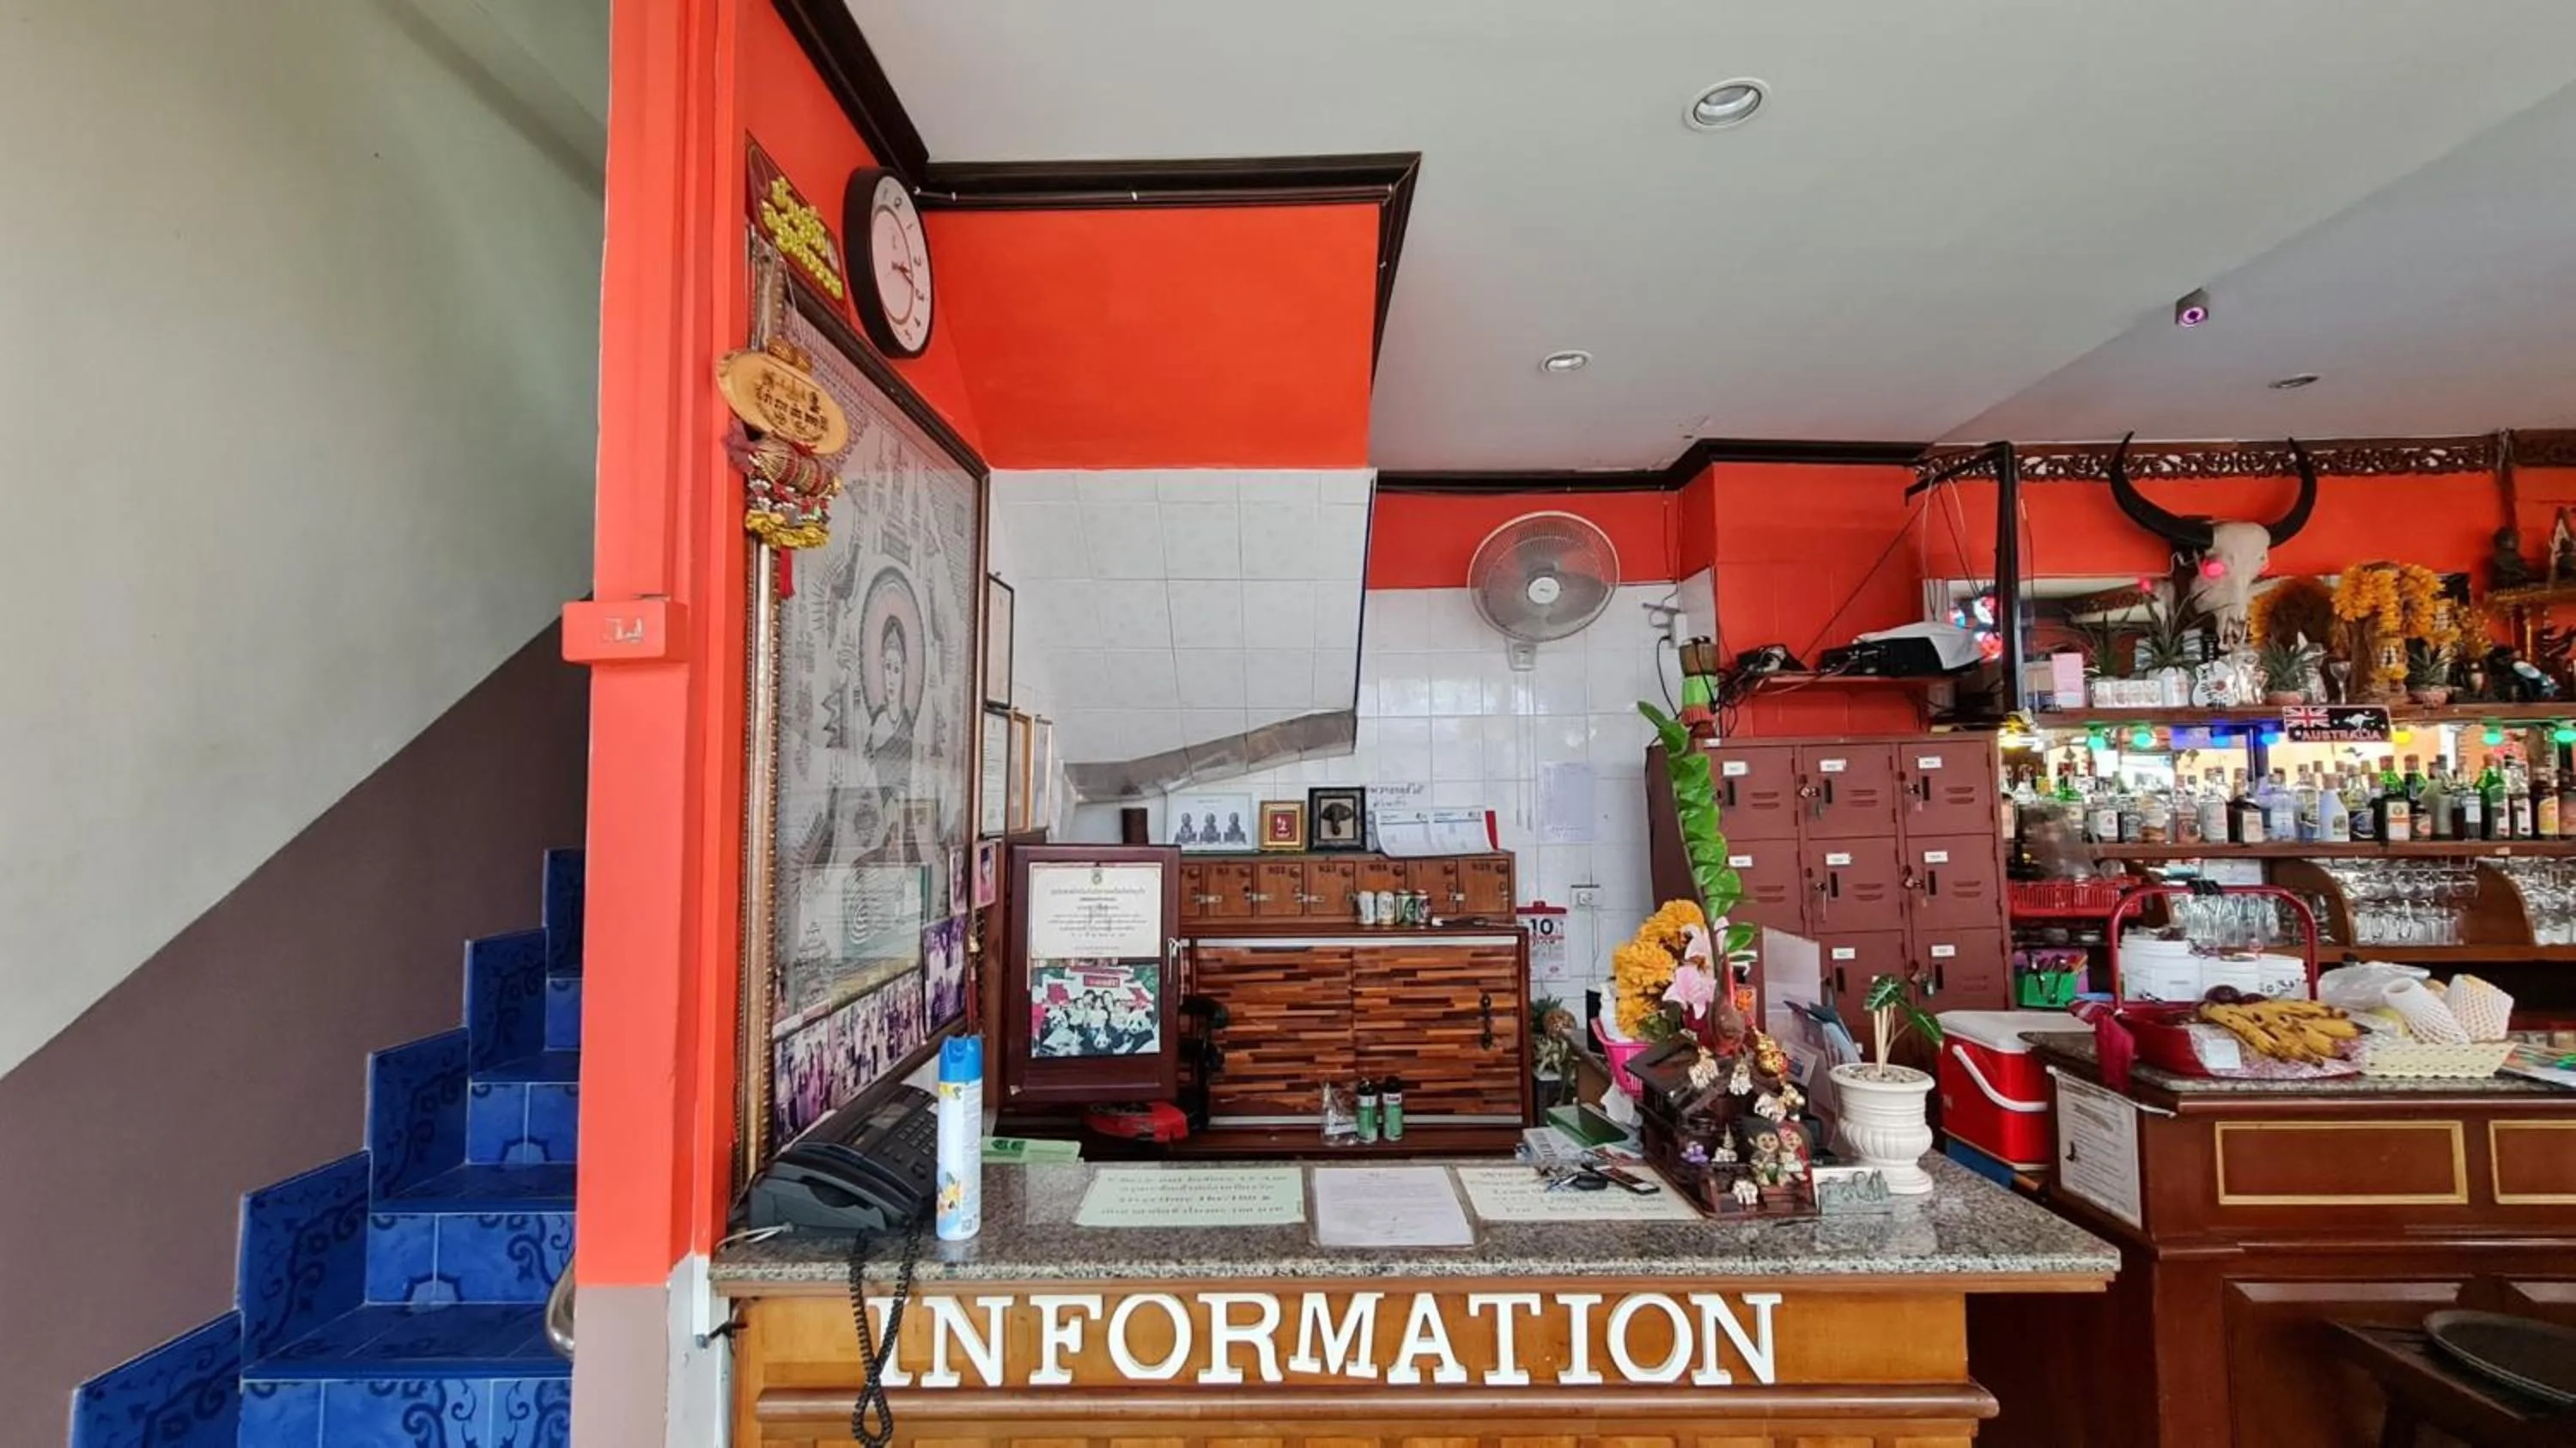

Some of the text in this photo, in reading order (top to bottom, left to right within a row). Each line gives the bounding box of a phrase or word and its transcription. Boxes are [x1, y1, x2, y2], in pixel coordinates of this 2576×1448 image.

[2301, 730, 2382, 741] AUSTRALIA
[1529, 917, 1554, 935] 10
[866, 1292, 1783, 1387] INFORMATION
